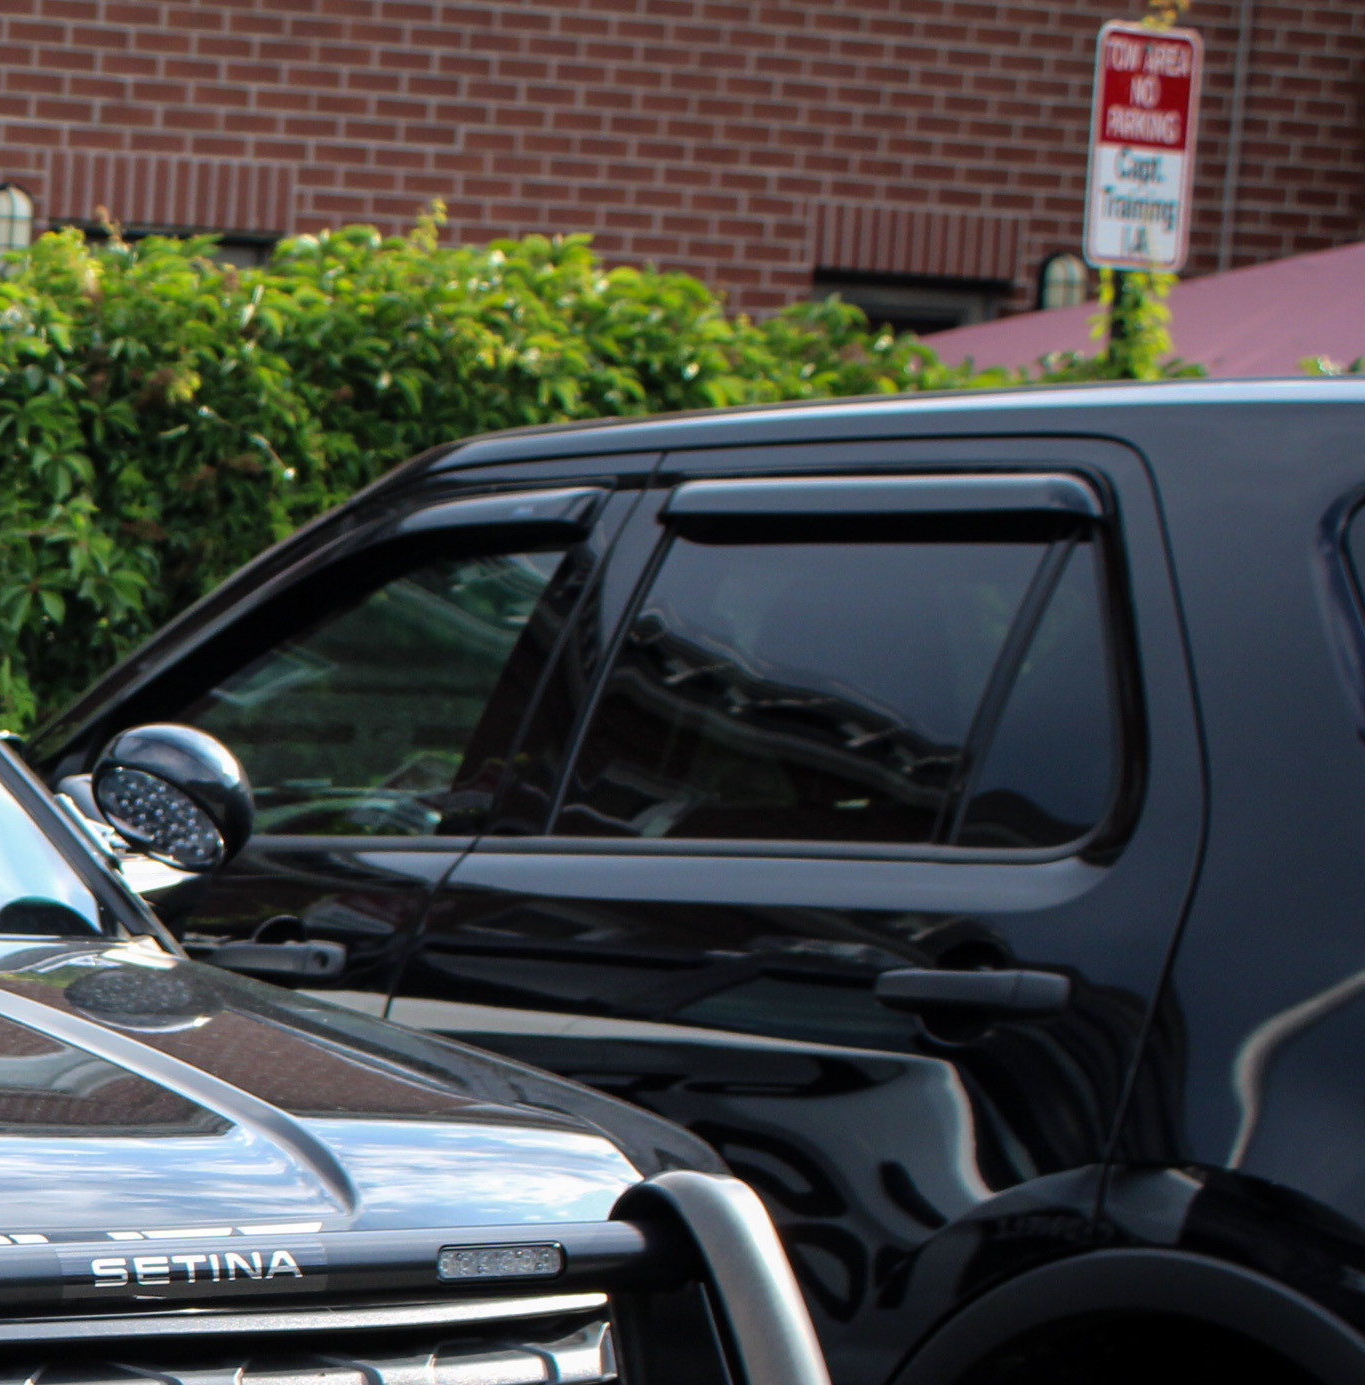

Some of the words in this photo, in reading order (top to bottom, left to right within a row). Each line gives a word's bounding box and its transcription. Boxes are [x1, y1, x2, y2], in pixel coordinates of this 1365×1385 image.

[1130, 77, 1161, 108] NO
[1107, 107, 1180, 143] PARKING
[1102, 187, 1177, 232] Training
[91, 1251, 304, 1288] SETINA
